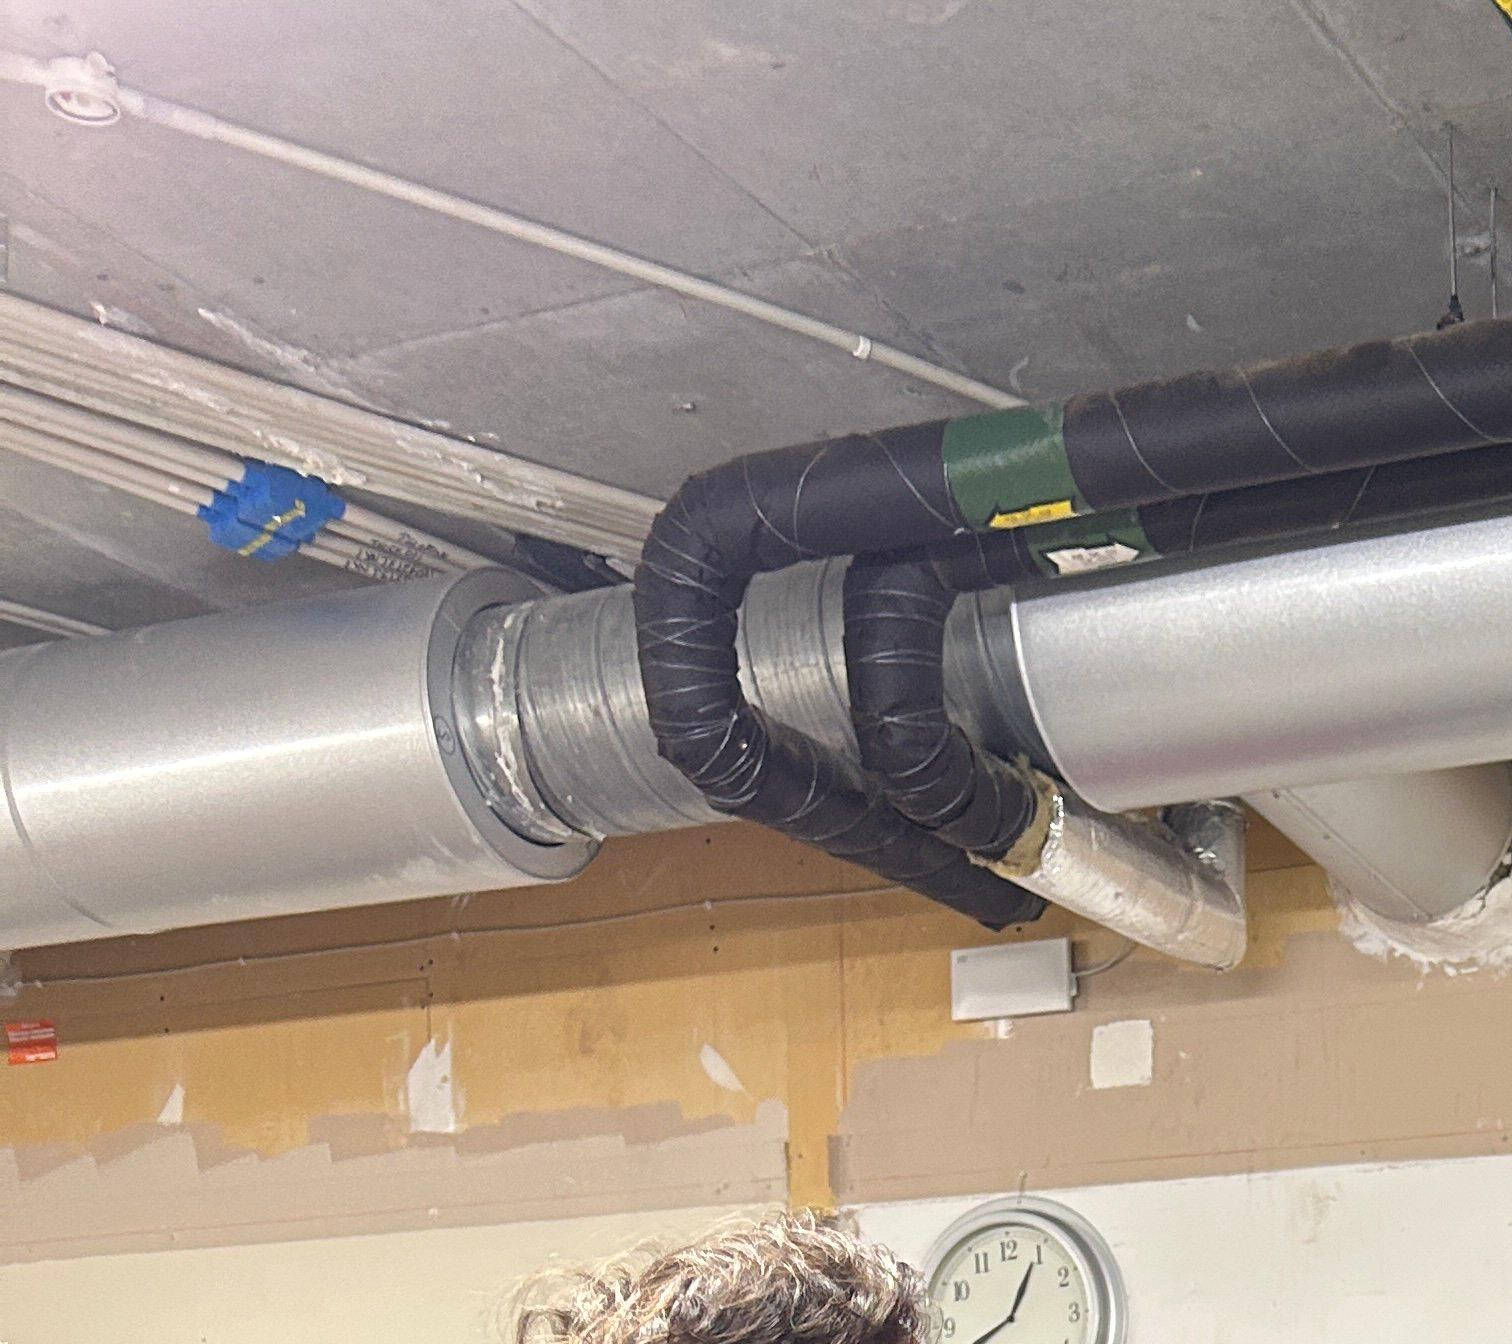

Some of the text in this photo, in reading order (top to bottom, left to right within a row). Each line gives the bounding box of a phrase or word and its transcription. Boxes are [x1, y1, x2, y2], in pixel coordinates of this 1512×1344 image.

[1000, 1240, 1018, 1262] 12
[1035, 1245, 1043, 1265] 1
[975, 1252, 989, 1274] 11
[1057, 1266, 1070, 1288] 2
[954, 1280, 970, 1302] 10
[1068, 1302, 1081, 1323] 3
[943, 1317, 956, 1339] 9
